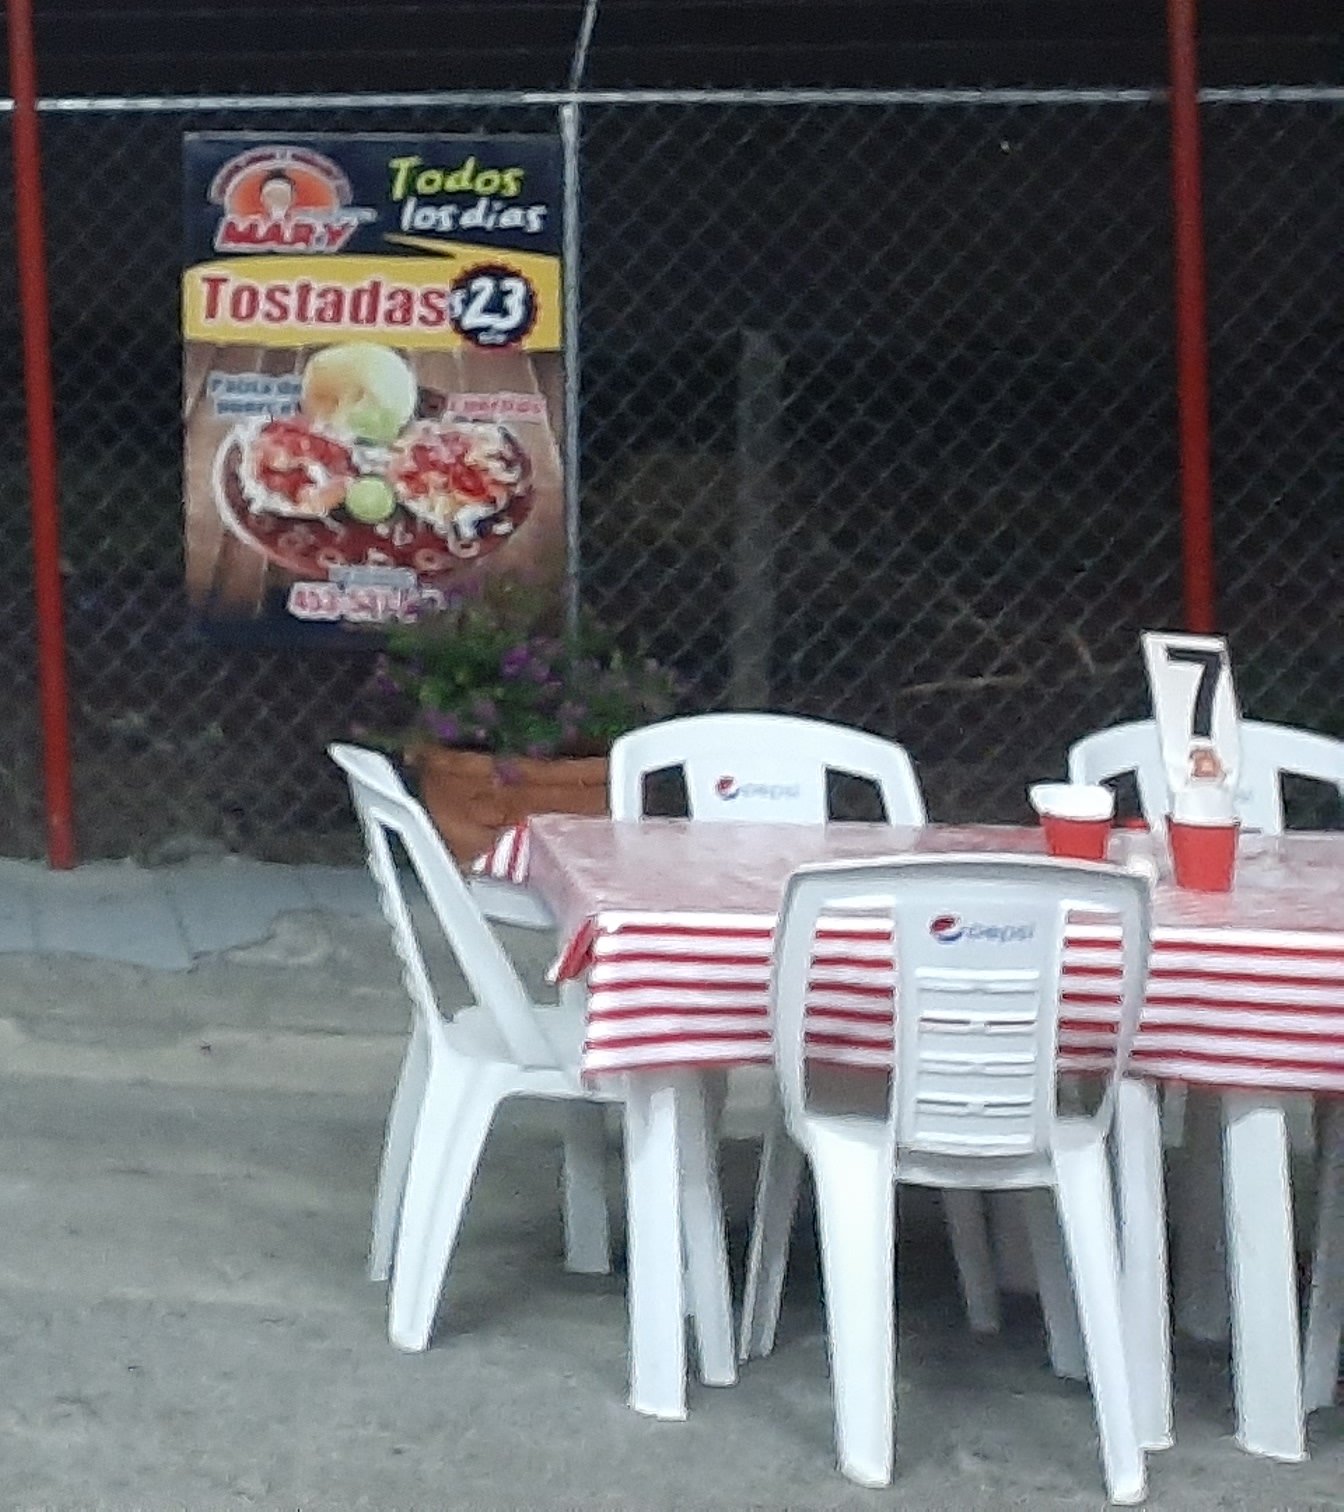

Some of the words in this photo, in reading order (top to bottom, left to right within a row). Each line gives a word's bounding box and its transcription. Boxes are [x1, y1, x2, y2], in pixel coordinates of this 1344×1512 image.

[389, 156, 525, 201] Todos
[200, 276, 448, 327] Tostadas
[1167, 647, 1222, 736] 7
